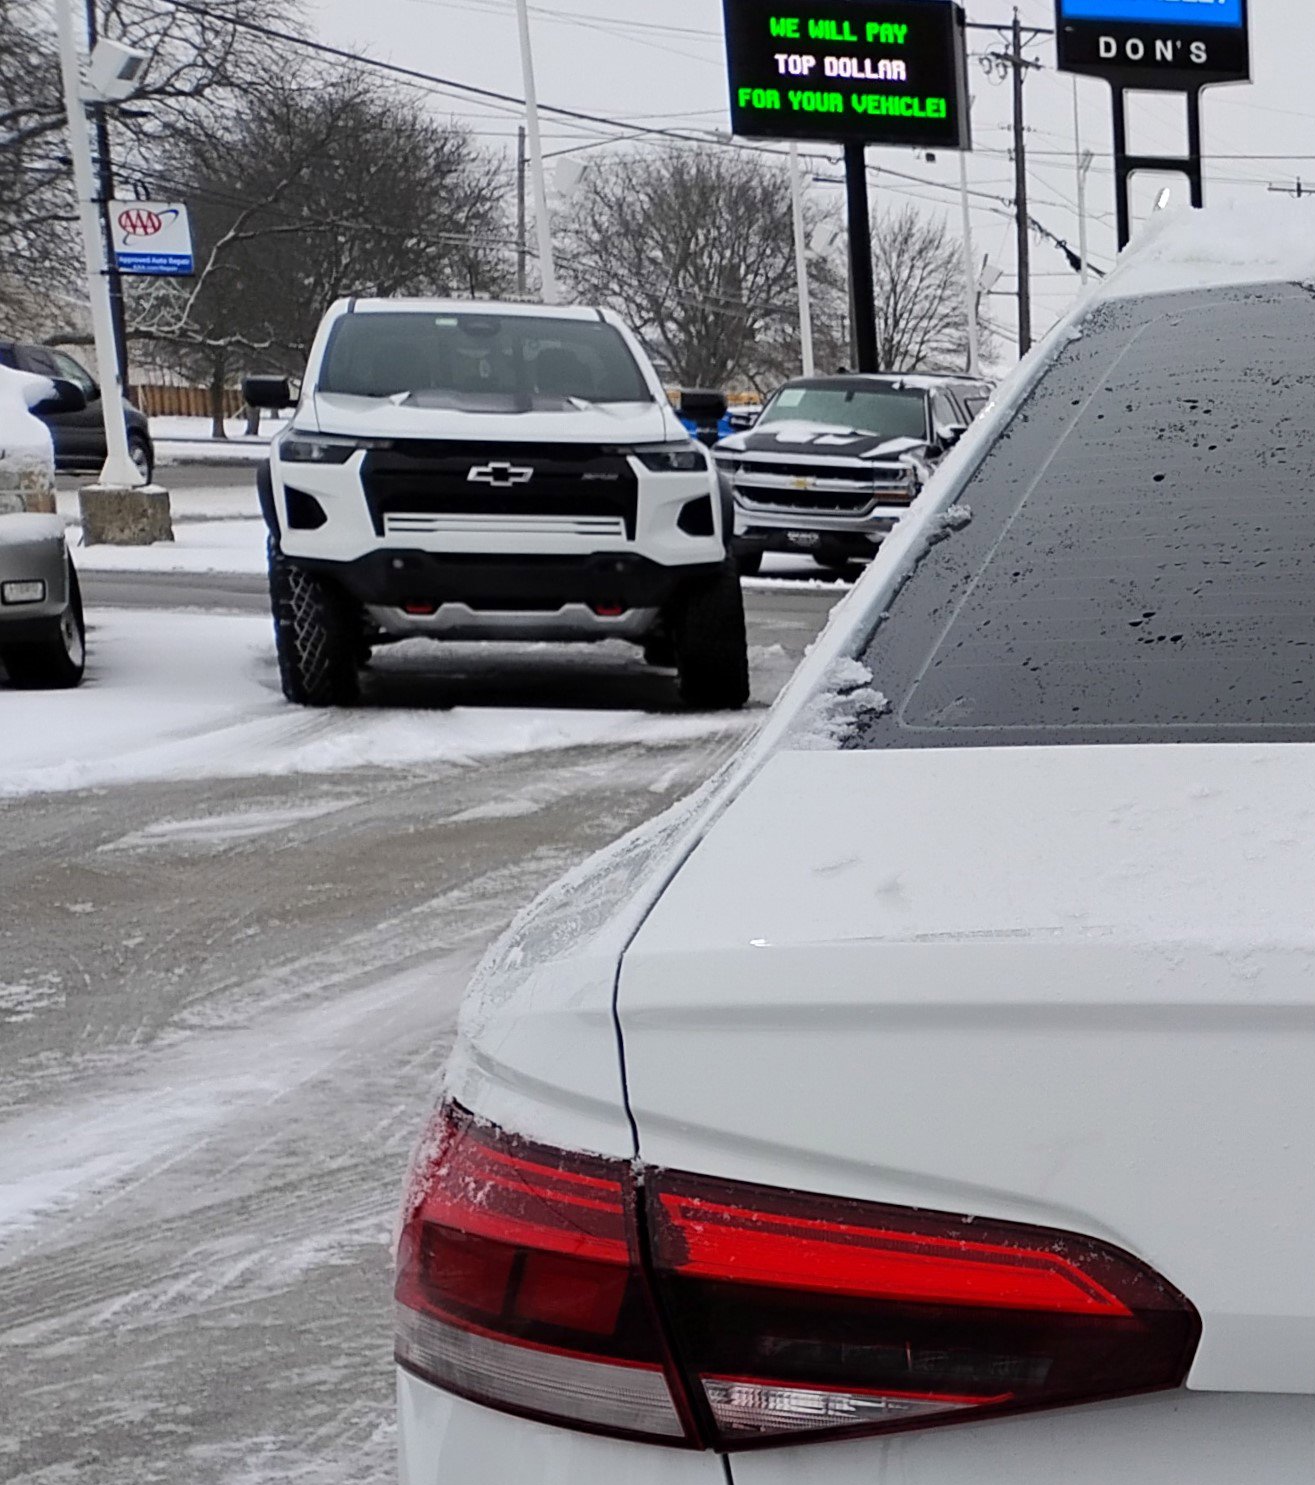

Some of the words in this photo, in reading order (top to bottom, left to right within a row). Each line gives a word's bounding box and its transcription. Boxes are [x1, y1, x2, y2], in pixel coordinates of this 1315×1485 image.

[770, 17, 800, 38] WE
[808, 19, 857, 41] WILL
[866, 22, 908, 44] PAY
[1099, 36, 1207, 64] DON'S
[774, 54, 816, 76] TOP
[824, 57, 906, 81] DOLLAR
[738, 88, 780, 109] FOR
[788, 90, 843, 113] YOUR
[852, 94, 946, 118] VEHICLE!
[121, 209, 161, 235] AAA
